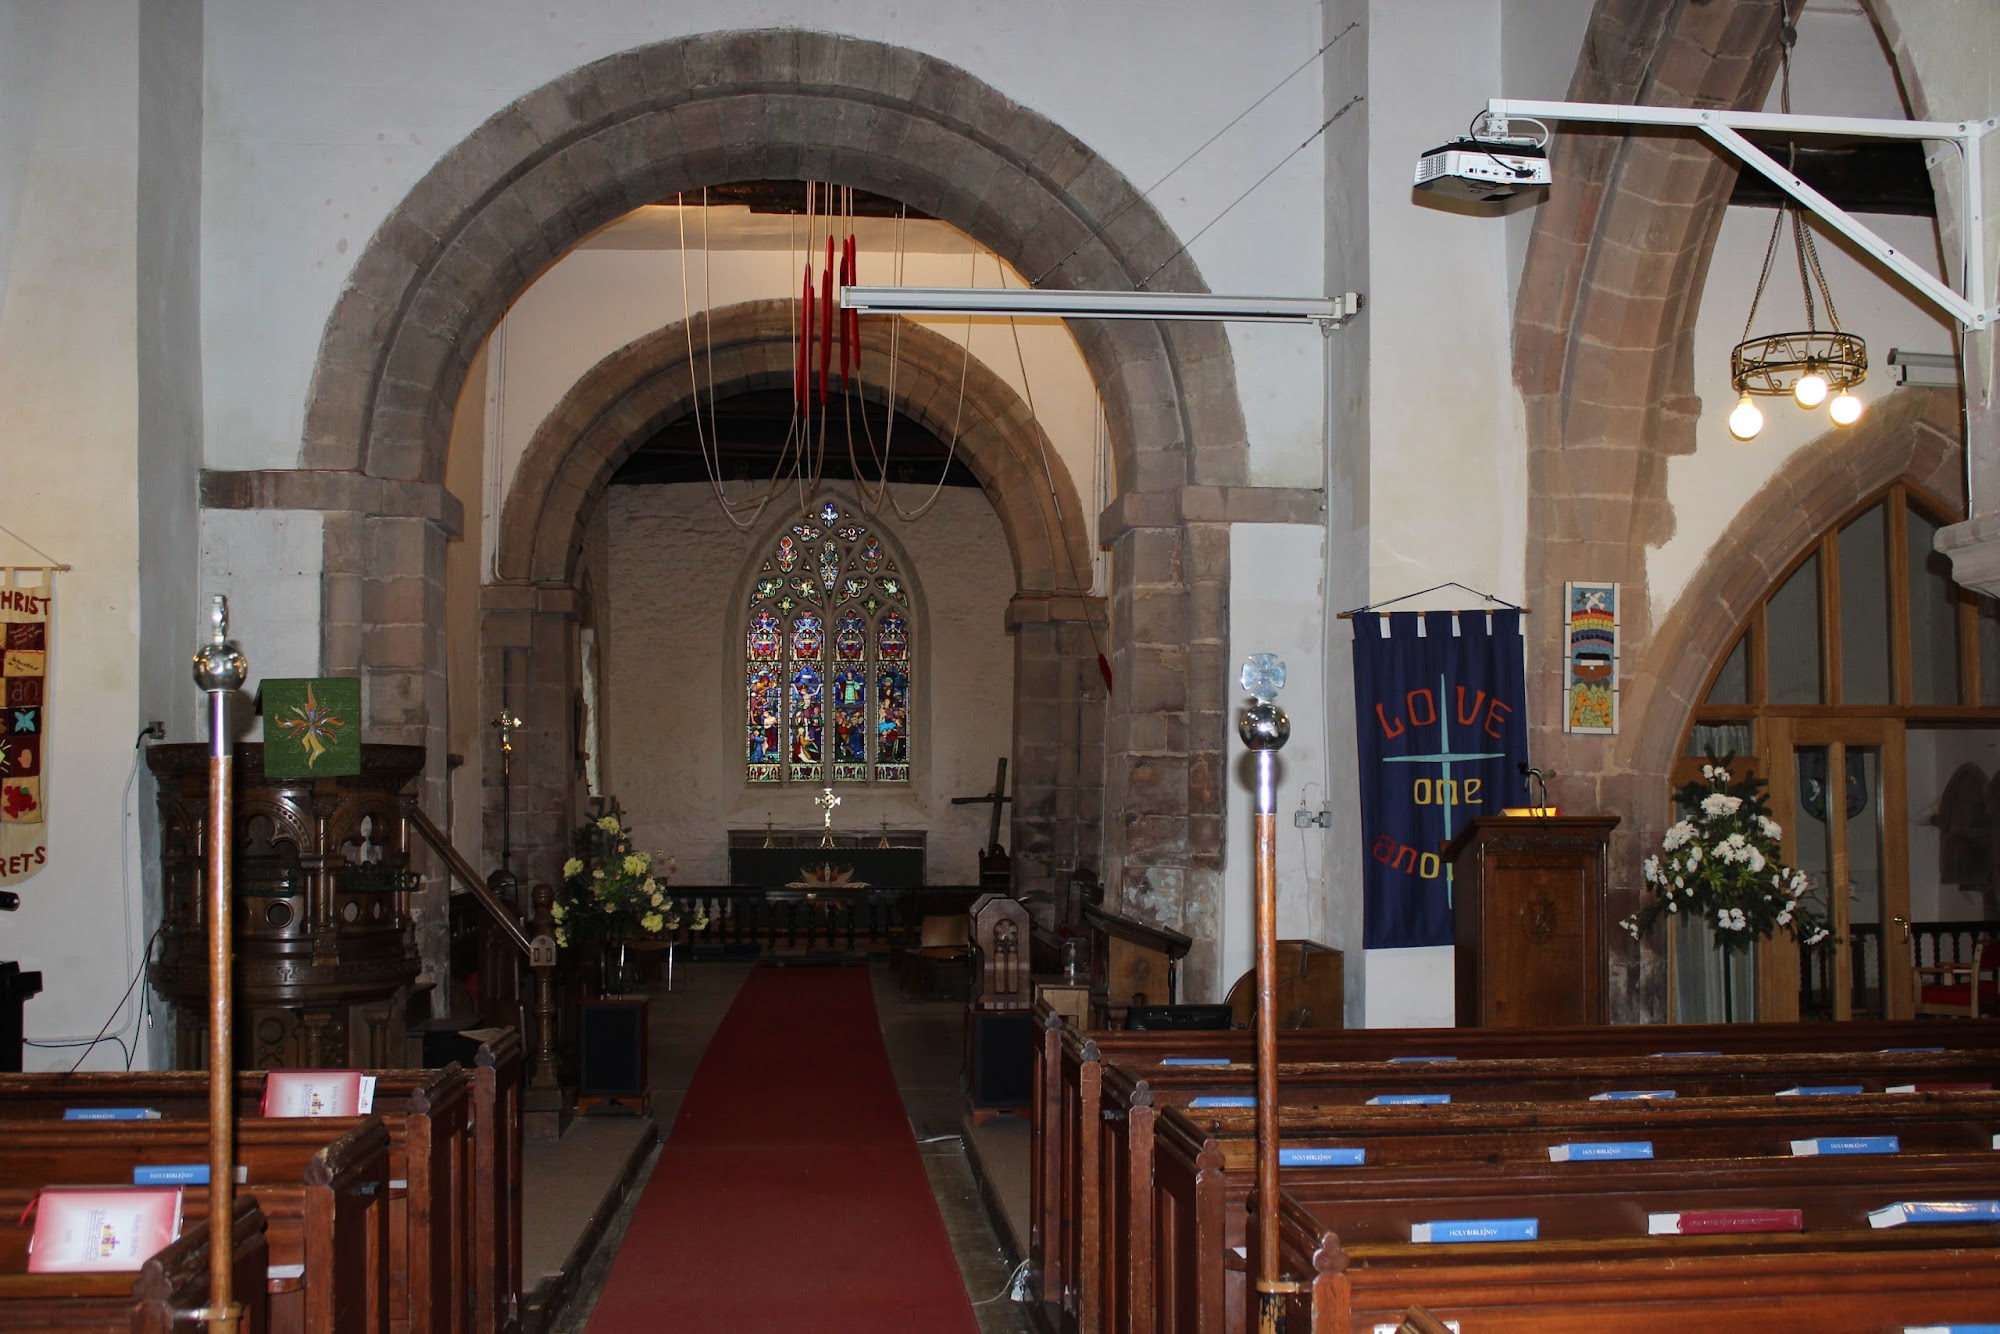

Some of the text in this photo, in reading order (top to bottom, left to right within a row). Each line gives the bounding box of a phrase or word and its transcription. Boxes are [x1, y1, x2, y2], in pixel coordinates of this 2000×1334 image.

[0, 590, 52, 616] HRIST
[1375, 685, 1512, 740] LOVE
[1413, 778, 1483, 806] one
[1372, 834, 1454, 881] ano
